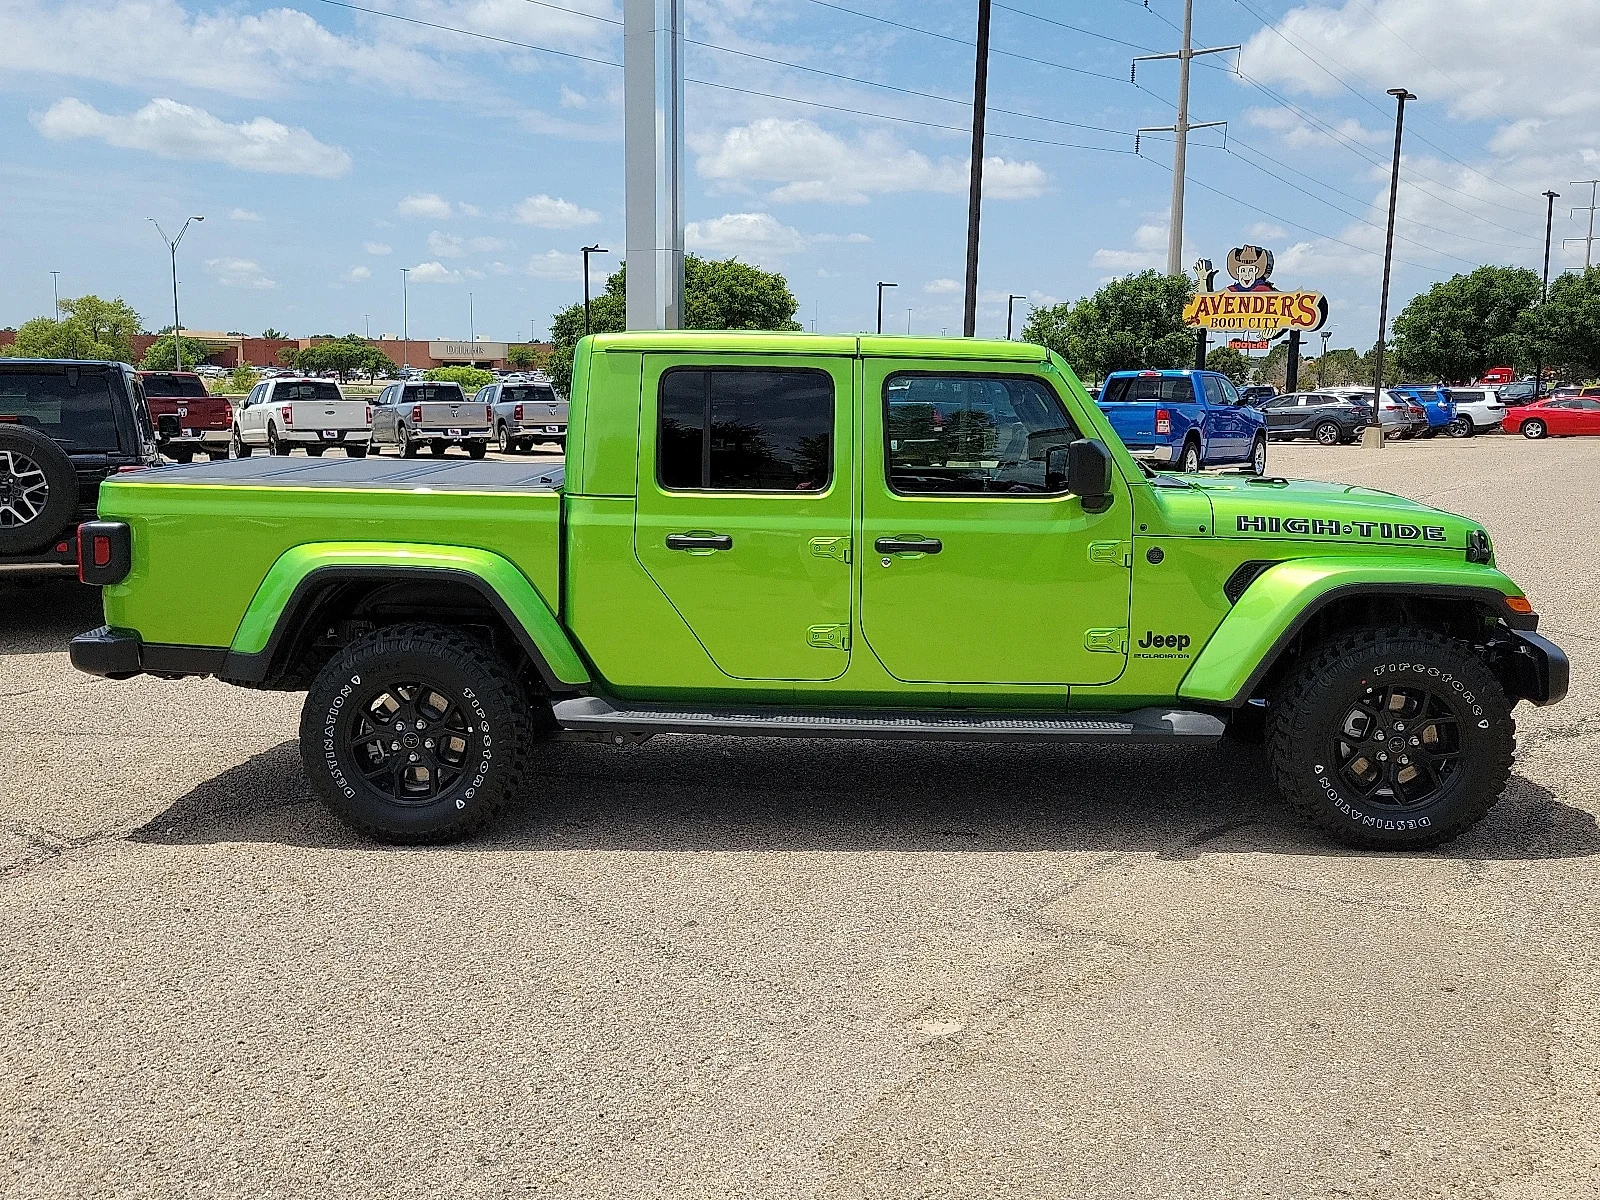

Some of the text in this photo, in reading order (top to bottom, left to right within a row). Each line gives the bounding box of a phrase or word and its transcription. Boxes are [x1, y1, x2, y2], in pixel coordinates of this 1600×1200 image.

[1184, 292, 1317, 327] AVENDER'S
[1210, 317, 1280, 329] BOOT CITY
[1138, 630, 1191, 652] Jeep
[323, 684, 355, 799] DESTINATION
[1318, 776, 1431, 831] DESTINATION
